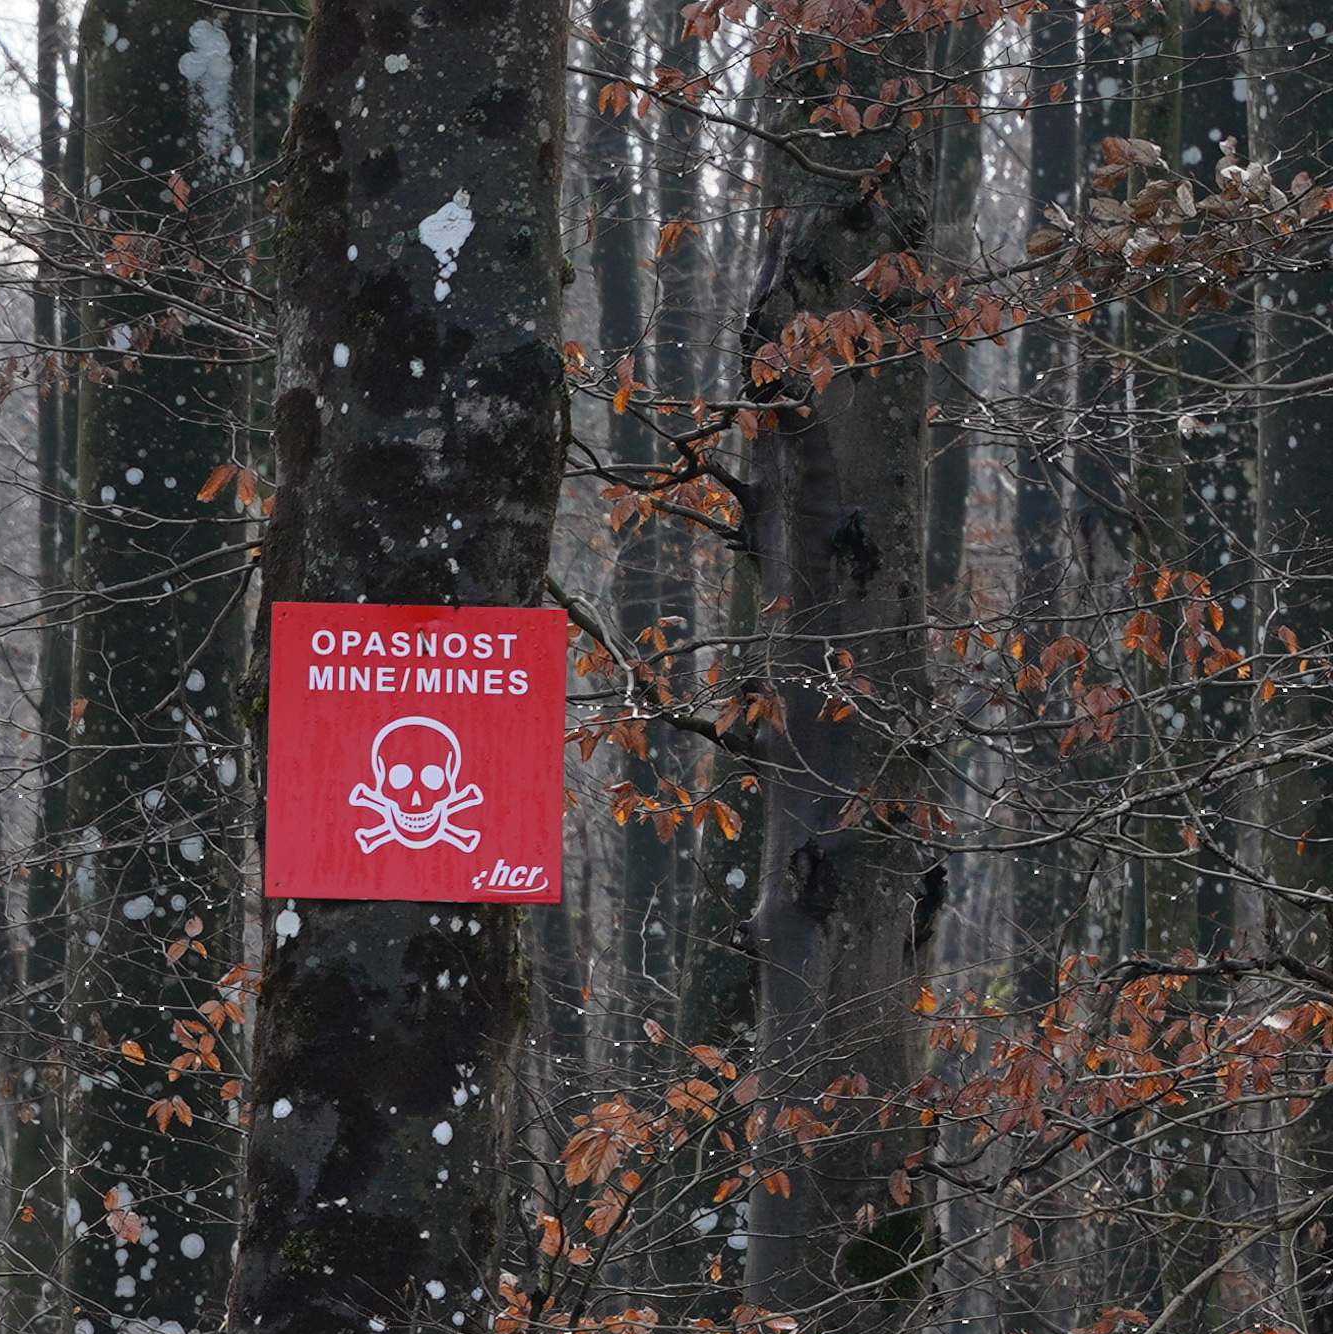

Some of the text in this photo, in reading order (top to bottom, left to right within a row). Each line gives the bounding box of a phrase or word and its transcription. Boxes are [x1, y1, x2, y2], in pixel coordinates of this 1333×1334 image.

[311, 630, 518, 659] OPASNOST
[308, 665, 529, 695] MINE/MINES
[487, 858, 544, 888] hcr
